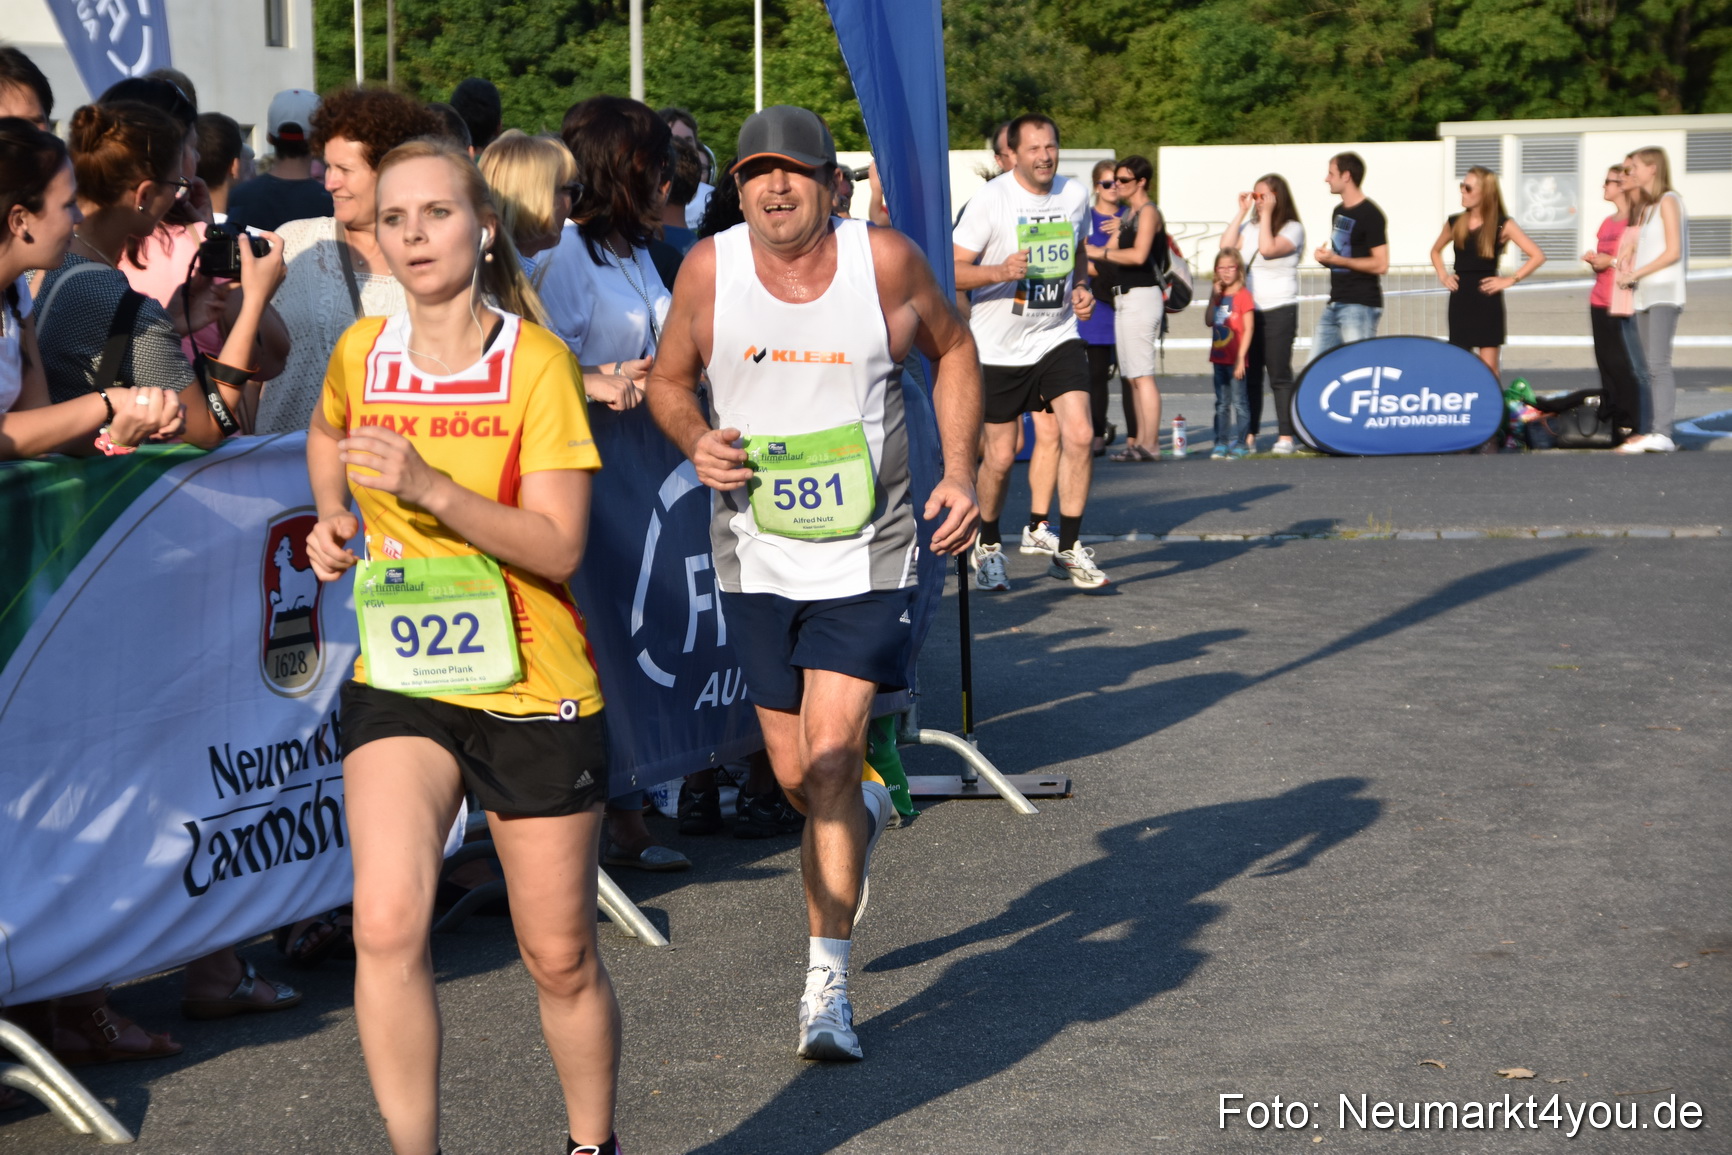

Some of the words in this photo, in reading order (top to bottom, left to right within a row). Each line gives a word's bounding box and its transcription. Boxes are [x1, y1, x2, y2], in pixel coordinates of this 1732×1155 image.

[1027, 243, 1069, 263] 1156
[1034, 284, 1059, 301] RW
[772, 349, 852, 365] KLEBL
[208, 393, 232, 427] SONY
[1351, 386, 1479, 416] Fischer
[429, 411, 509, 437] BÖGL
[1364, 414, 1471, 429] AUTOMOBILE
[761, 452, 804, 461] firmenlauf
[773, 472, 844, 511] 581
[375, 582, 424, 593] firmenlauf
[390, 611, 485, 658] 922
[274, 650, 308, 679] 1628
[412, 667, 447, 676] Simone
[448, 665, 473, 674] Plank
